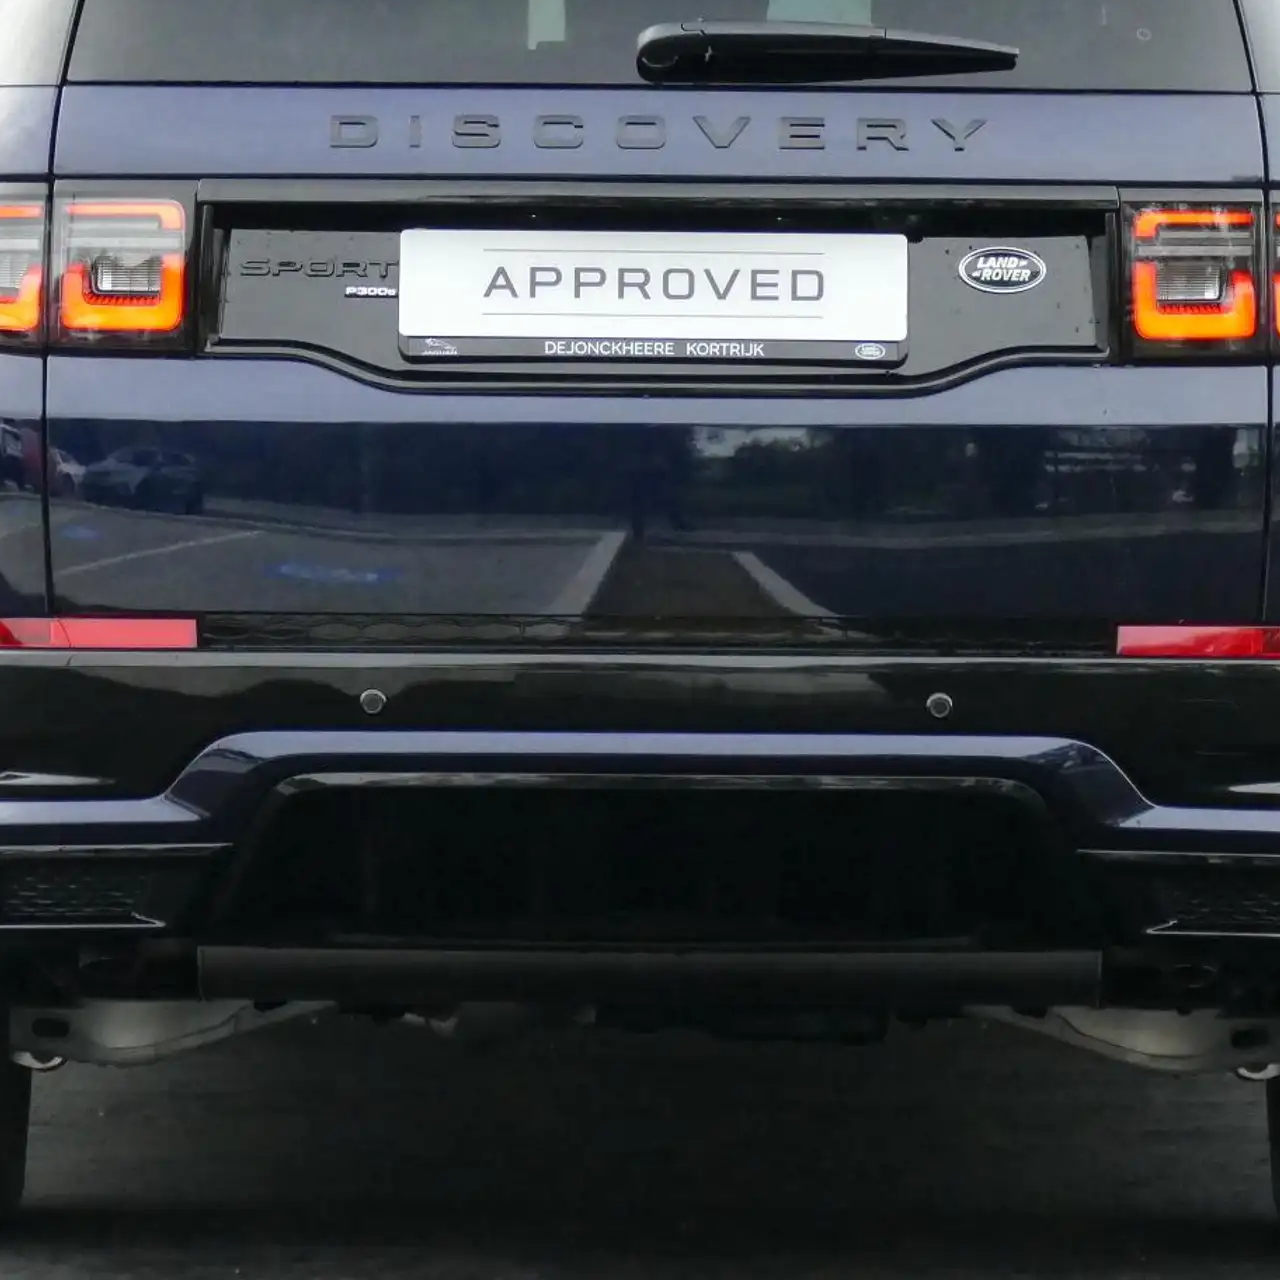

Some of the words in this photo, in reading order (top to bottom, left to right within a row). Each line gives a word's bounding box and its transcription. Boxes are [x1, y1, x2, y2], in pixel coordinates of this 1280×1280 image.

[329, 114, 988, 152] DISCOVERY
[239, 260, 399, 279] SPORT
[977, 257, 1019, 269] LAND
[483, 266, 824, 301] APPROVED
[981, 269, 1031, 281] ROVER
[544, 341, 675, 355] DEJONCKHEERE
[686, 343, 764, 357] KORTRIJK
